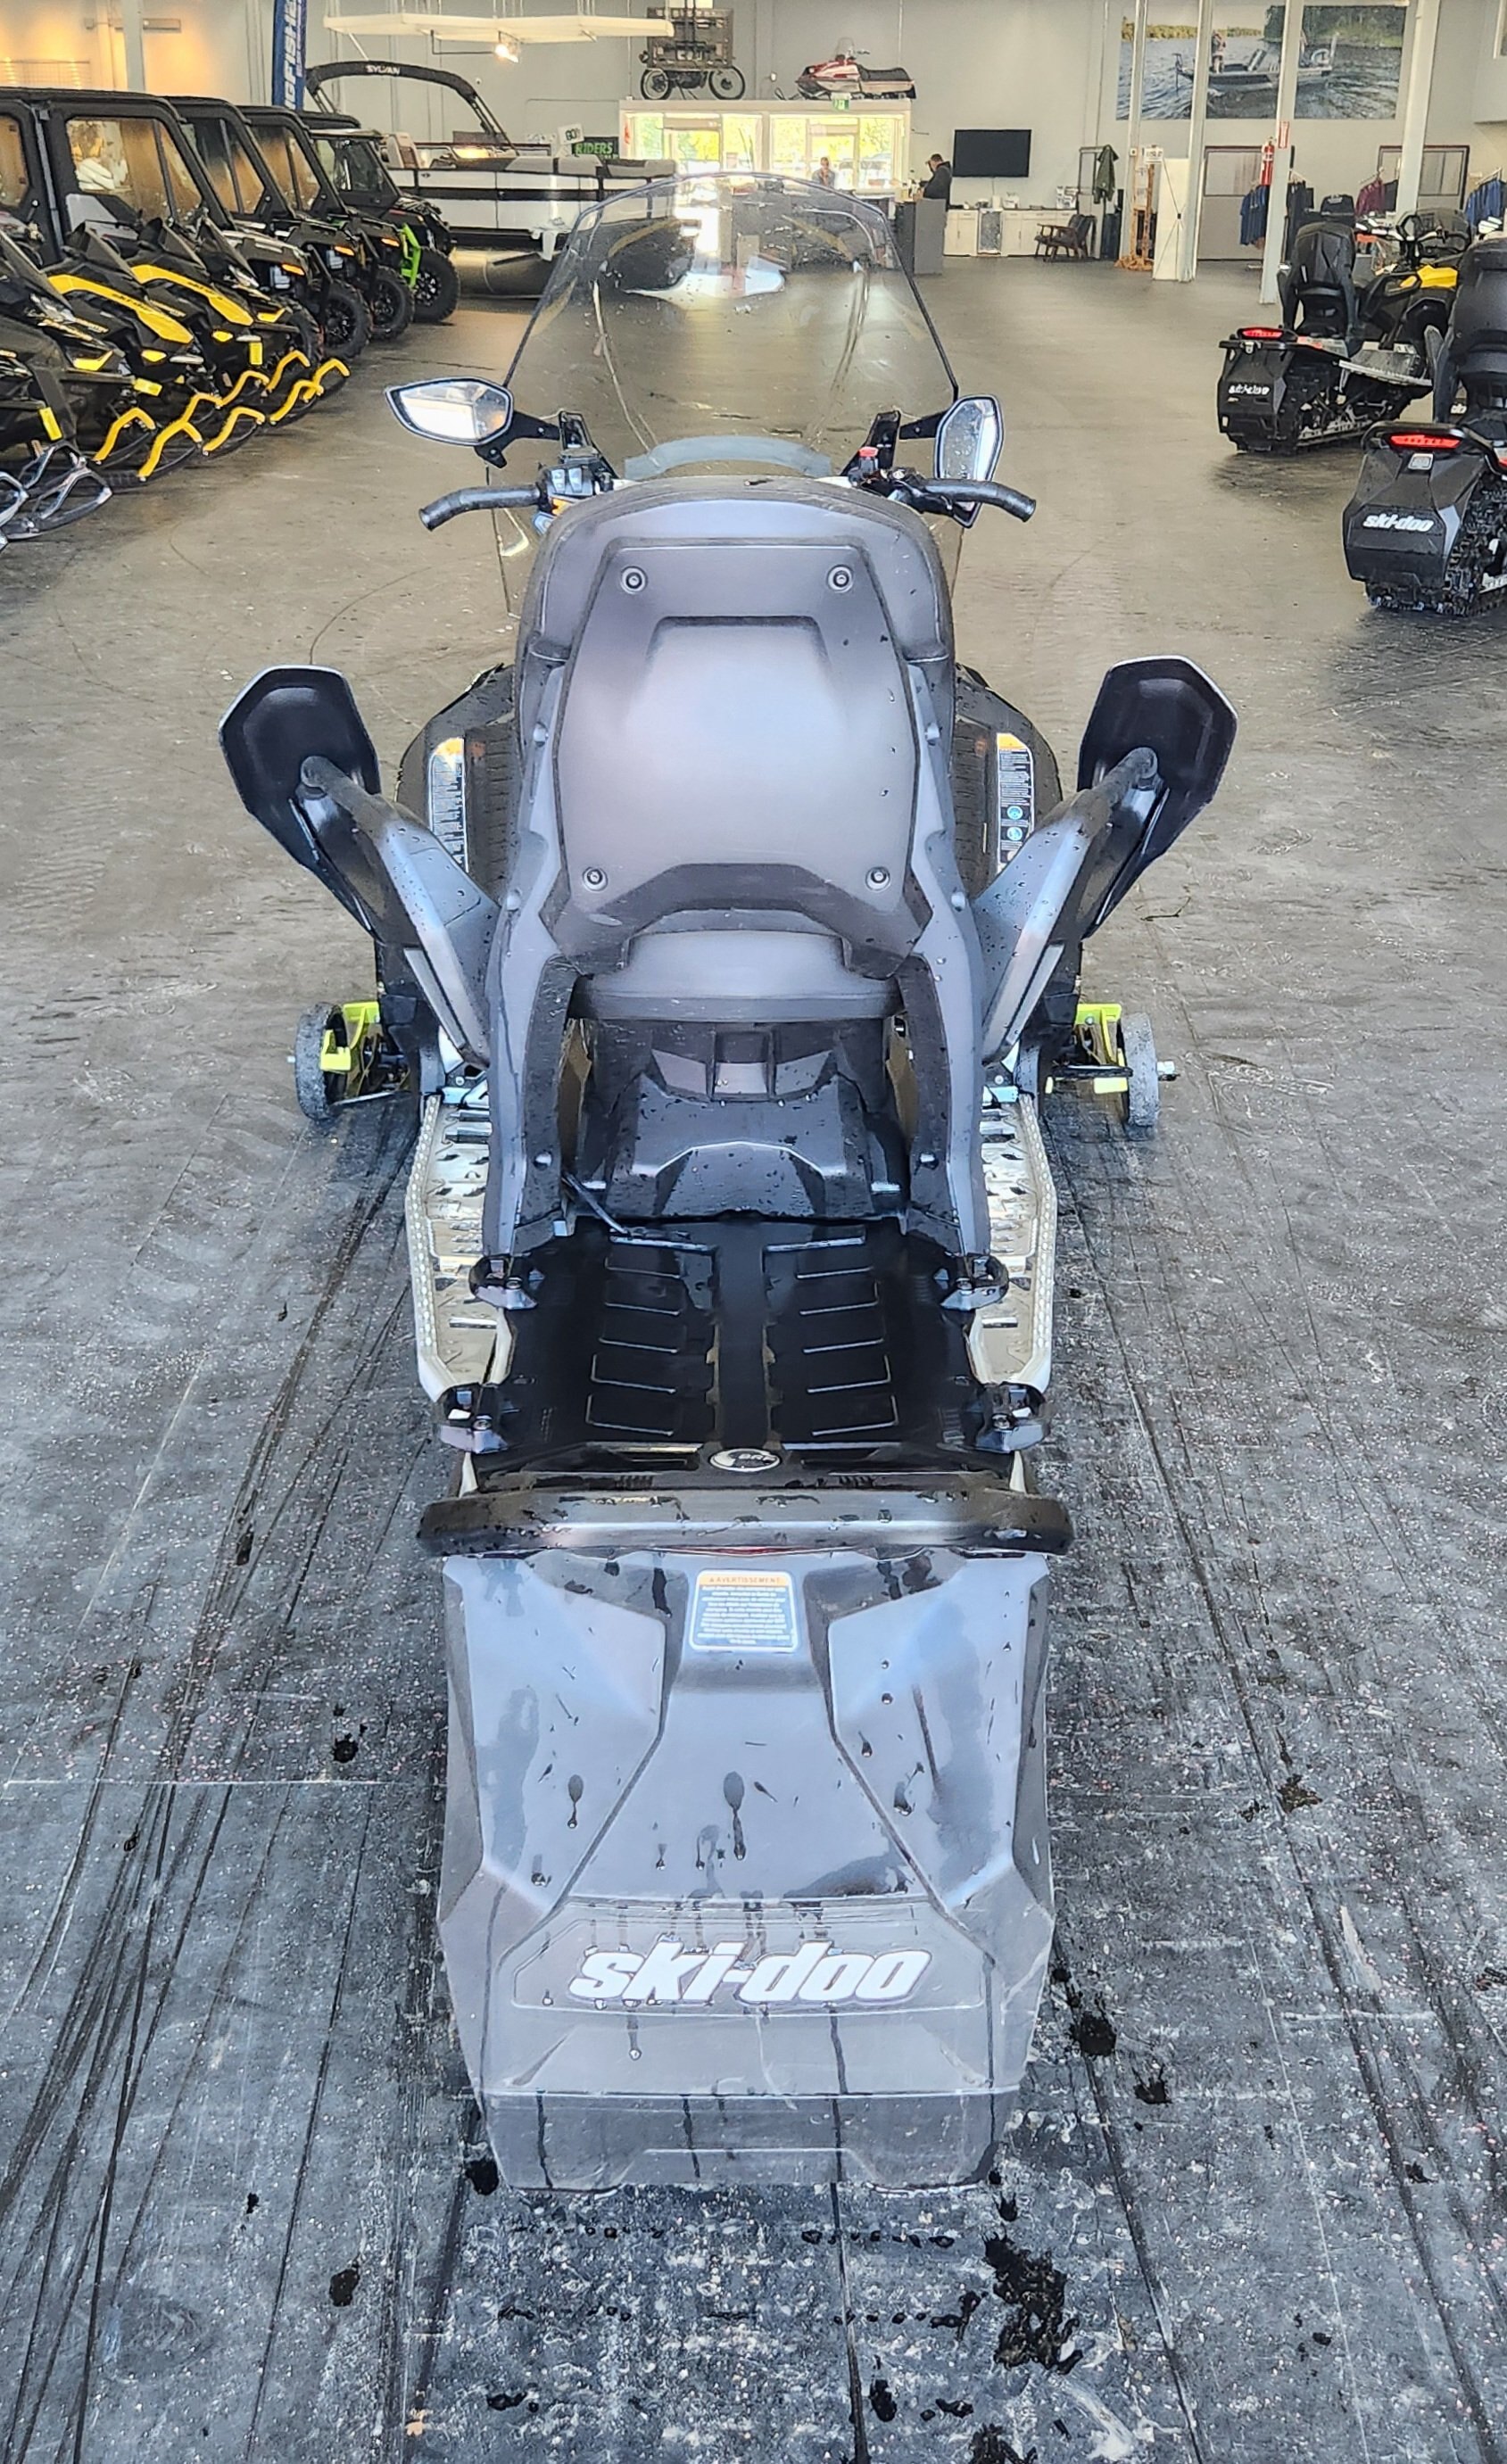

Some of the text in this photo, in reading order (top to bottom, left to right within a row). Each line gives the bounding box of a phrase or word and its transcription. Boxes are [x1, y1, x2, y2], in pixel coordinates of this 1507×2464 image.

[365, 64, 401, 75] SYLVAN
[575, 143, 613, 154] RIDERS
[1362, 513, 1434, 532] ski-doo
[567, 1939, 932, 2003] ski-doo
